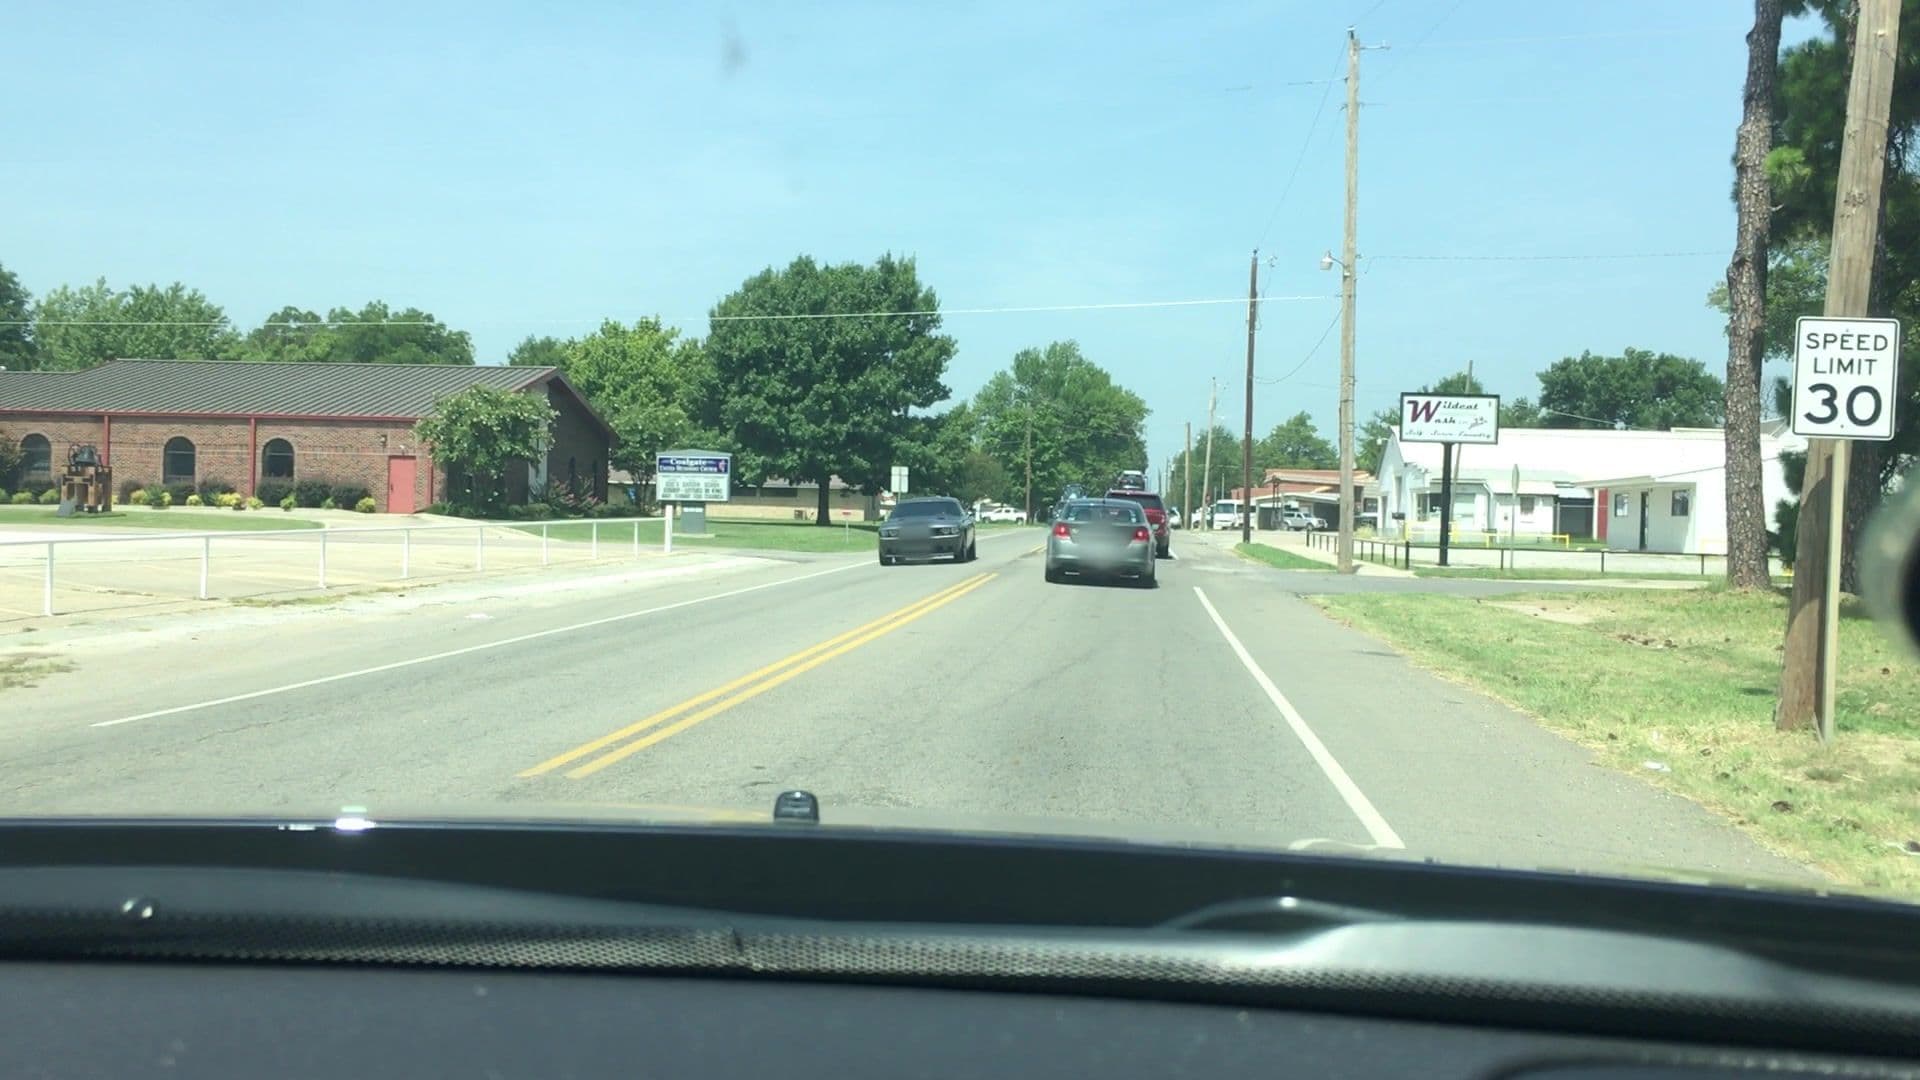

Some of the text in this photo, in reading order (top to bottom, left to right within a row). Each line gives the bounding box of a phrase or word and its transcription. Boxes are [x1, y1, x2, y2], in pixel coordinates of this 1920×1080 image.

[1805, 332, 1888, 352] SPEED
[1813, 357, 1878, 376] LIMIT
[1803, 382, 1883, 427] 30
